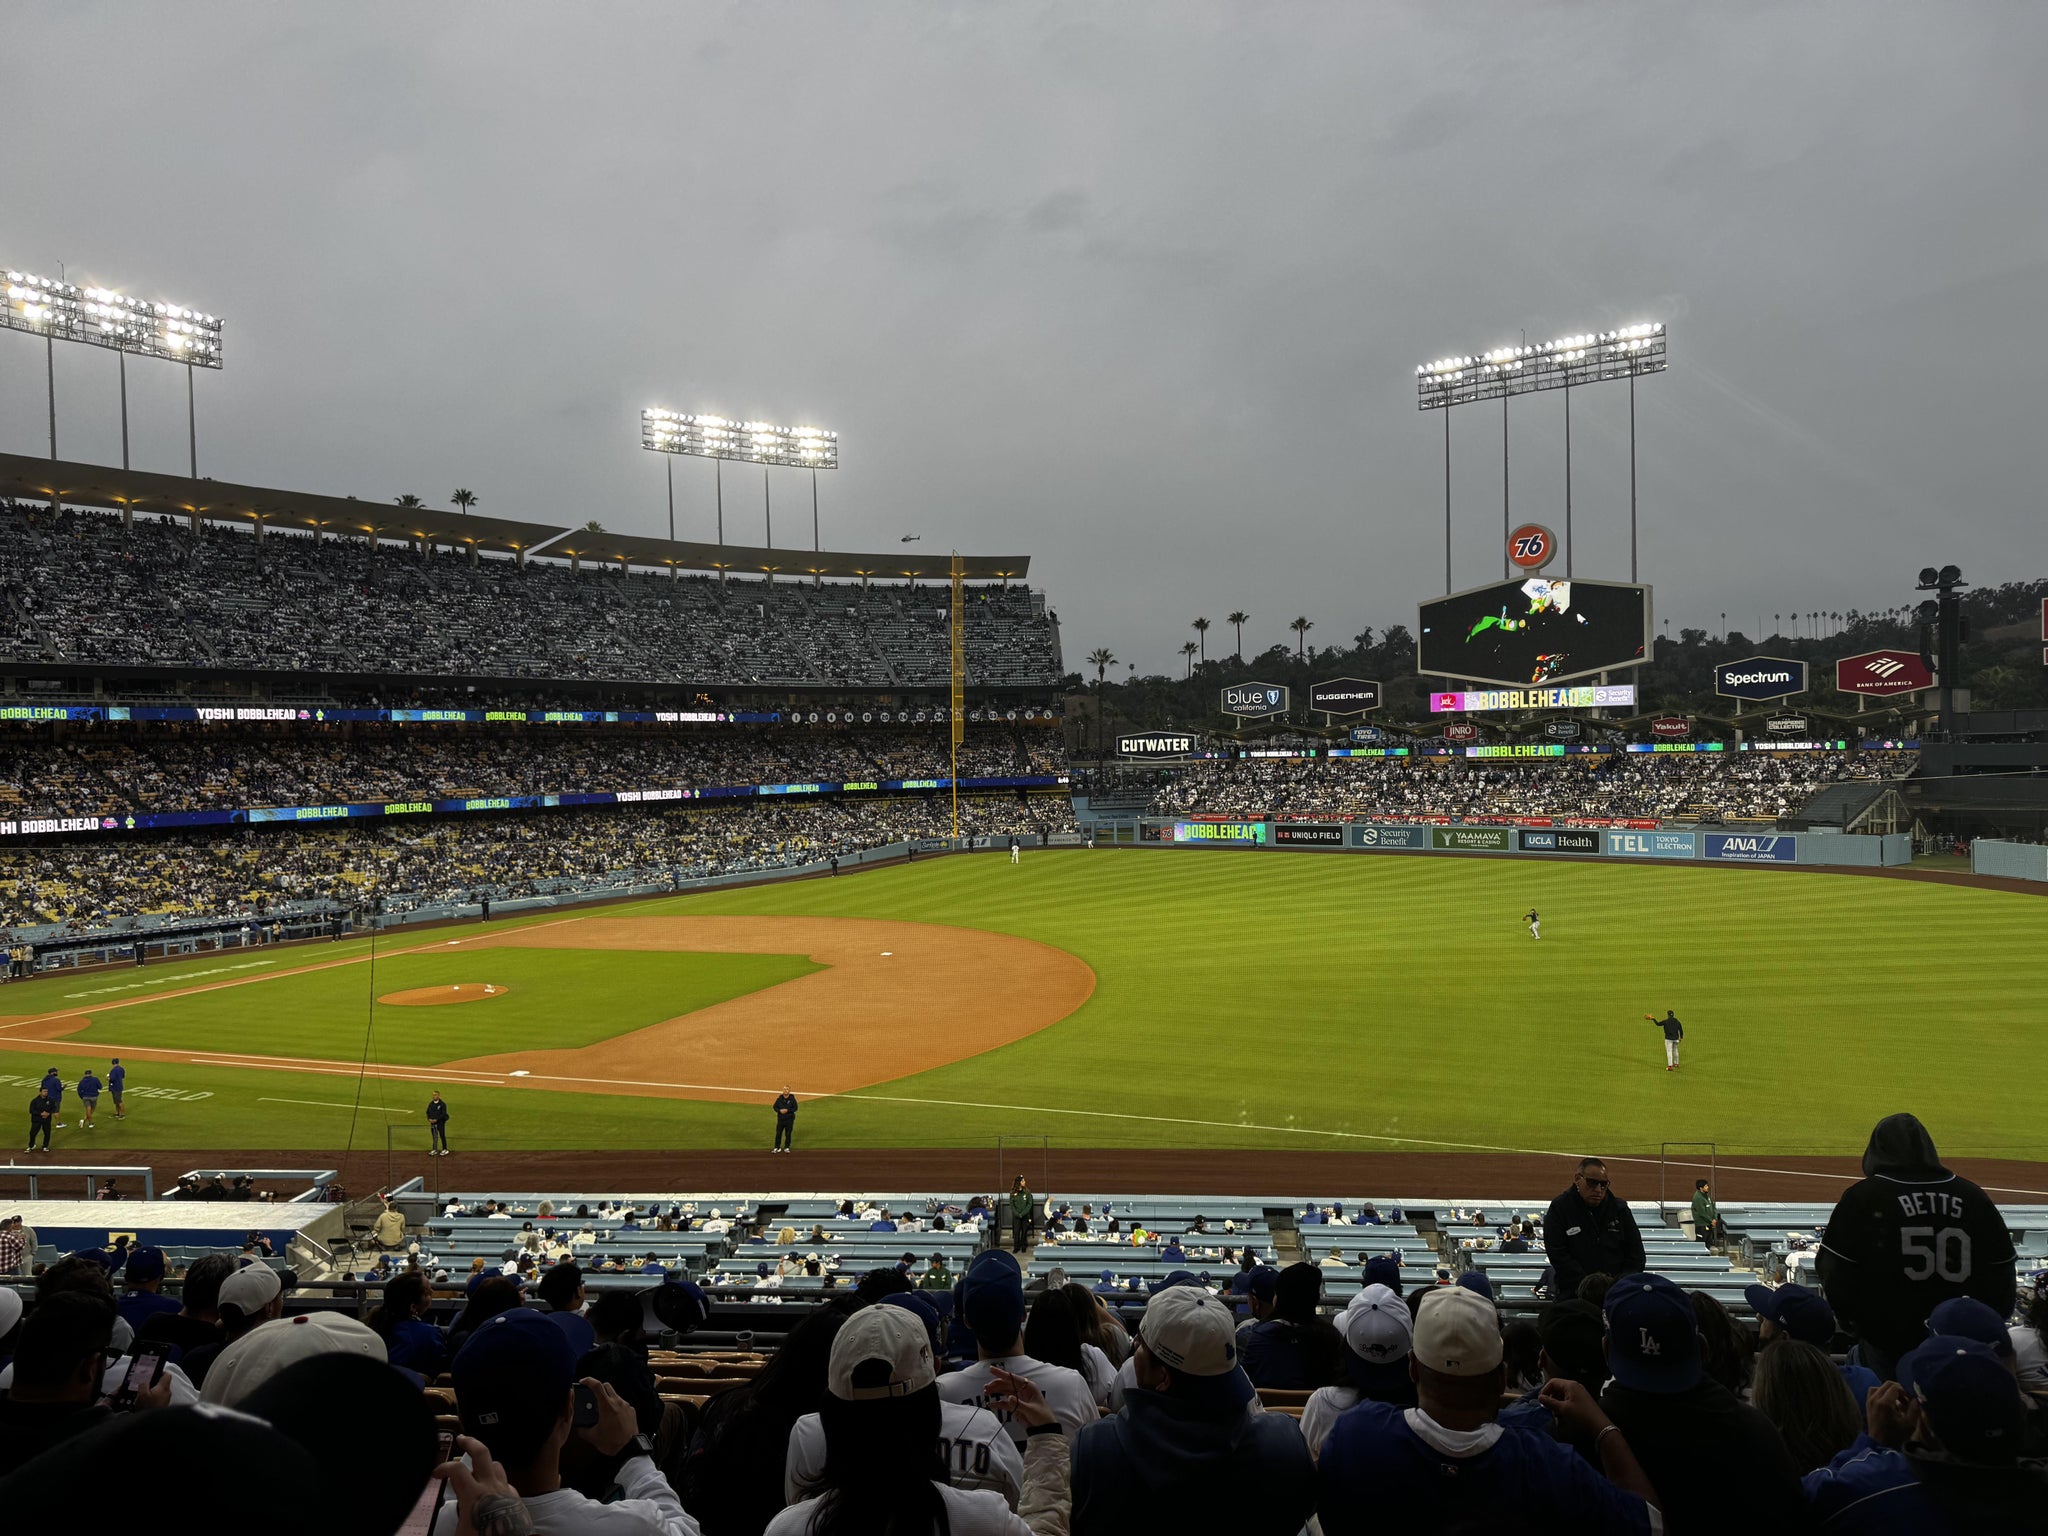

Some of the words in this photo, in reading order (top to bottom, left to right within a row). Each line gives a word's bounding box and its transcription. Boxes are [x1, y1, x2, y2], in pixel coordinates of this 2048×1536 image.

[1515, 533, 1543, 558] 76
[1726, 672, 1789, 686] Spectrum
[1228, 690, 1262, 704] blue
[1316, 692, 1373, 700] GUGGENHEIM
[1479, 690, 1579, 709] BOBBLEHEAD
[0, 708, 68, 720] BOBBLEHEAD
[197, 708, 234, 720] YOSHI
[237, 708, 296, 720] BOBBLEHEAD
[422, 712, 465, 720] BOBBLEHEAD
[486, 712, 526, 721] BOBBLEHEAD
[545, 712, 583, 721] BOBBLEHEAD
[656, 713, 678, 721] YOSHI
[1449, 726, 1472, 736] JINRO
[1122, 739, 1189, 752] CUTWATER
[1477, 746, 1553, 757] BOBBLEHEAD
[786, 784, 819, 793] BOBBLEHEAD
[843, 783, 877, 791] BOBBLEHEAD
[902, 780, 937, 788] BOBBLEHEAD
[616, 792, 641, 802] YOSHI
[385, 803, 432, 814] BOBBLEHEAD
[466, 800, 509, 810] BOBBLEHEAD
[296, 807, 348, 819] BOBBLEHEAD
[21, 818, 99, 833] BOBBLEHEAD
[1184, 825, 1256, 839] BOBBLEHEAD
[1380, 829, 1411, 838] Security
[1529, 836, 1551, 845] UCLA
[1558, 836, 1592, 847] Health
[1611, 835, 1649, 852] TEL
[1722, 838, 1758, 851] ANA
[122, 1086, 215, 1101] FIELD
[1898, 1192, 1963, 1218] BETTS
[1900, 1226, 1971, 1282] 50
[1640, 1327, 1661, 1355] LA
